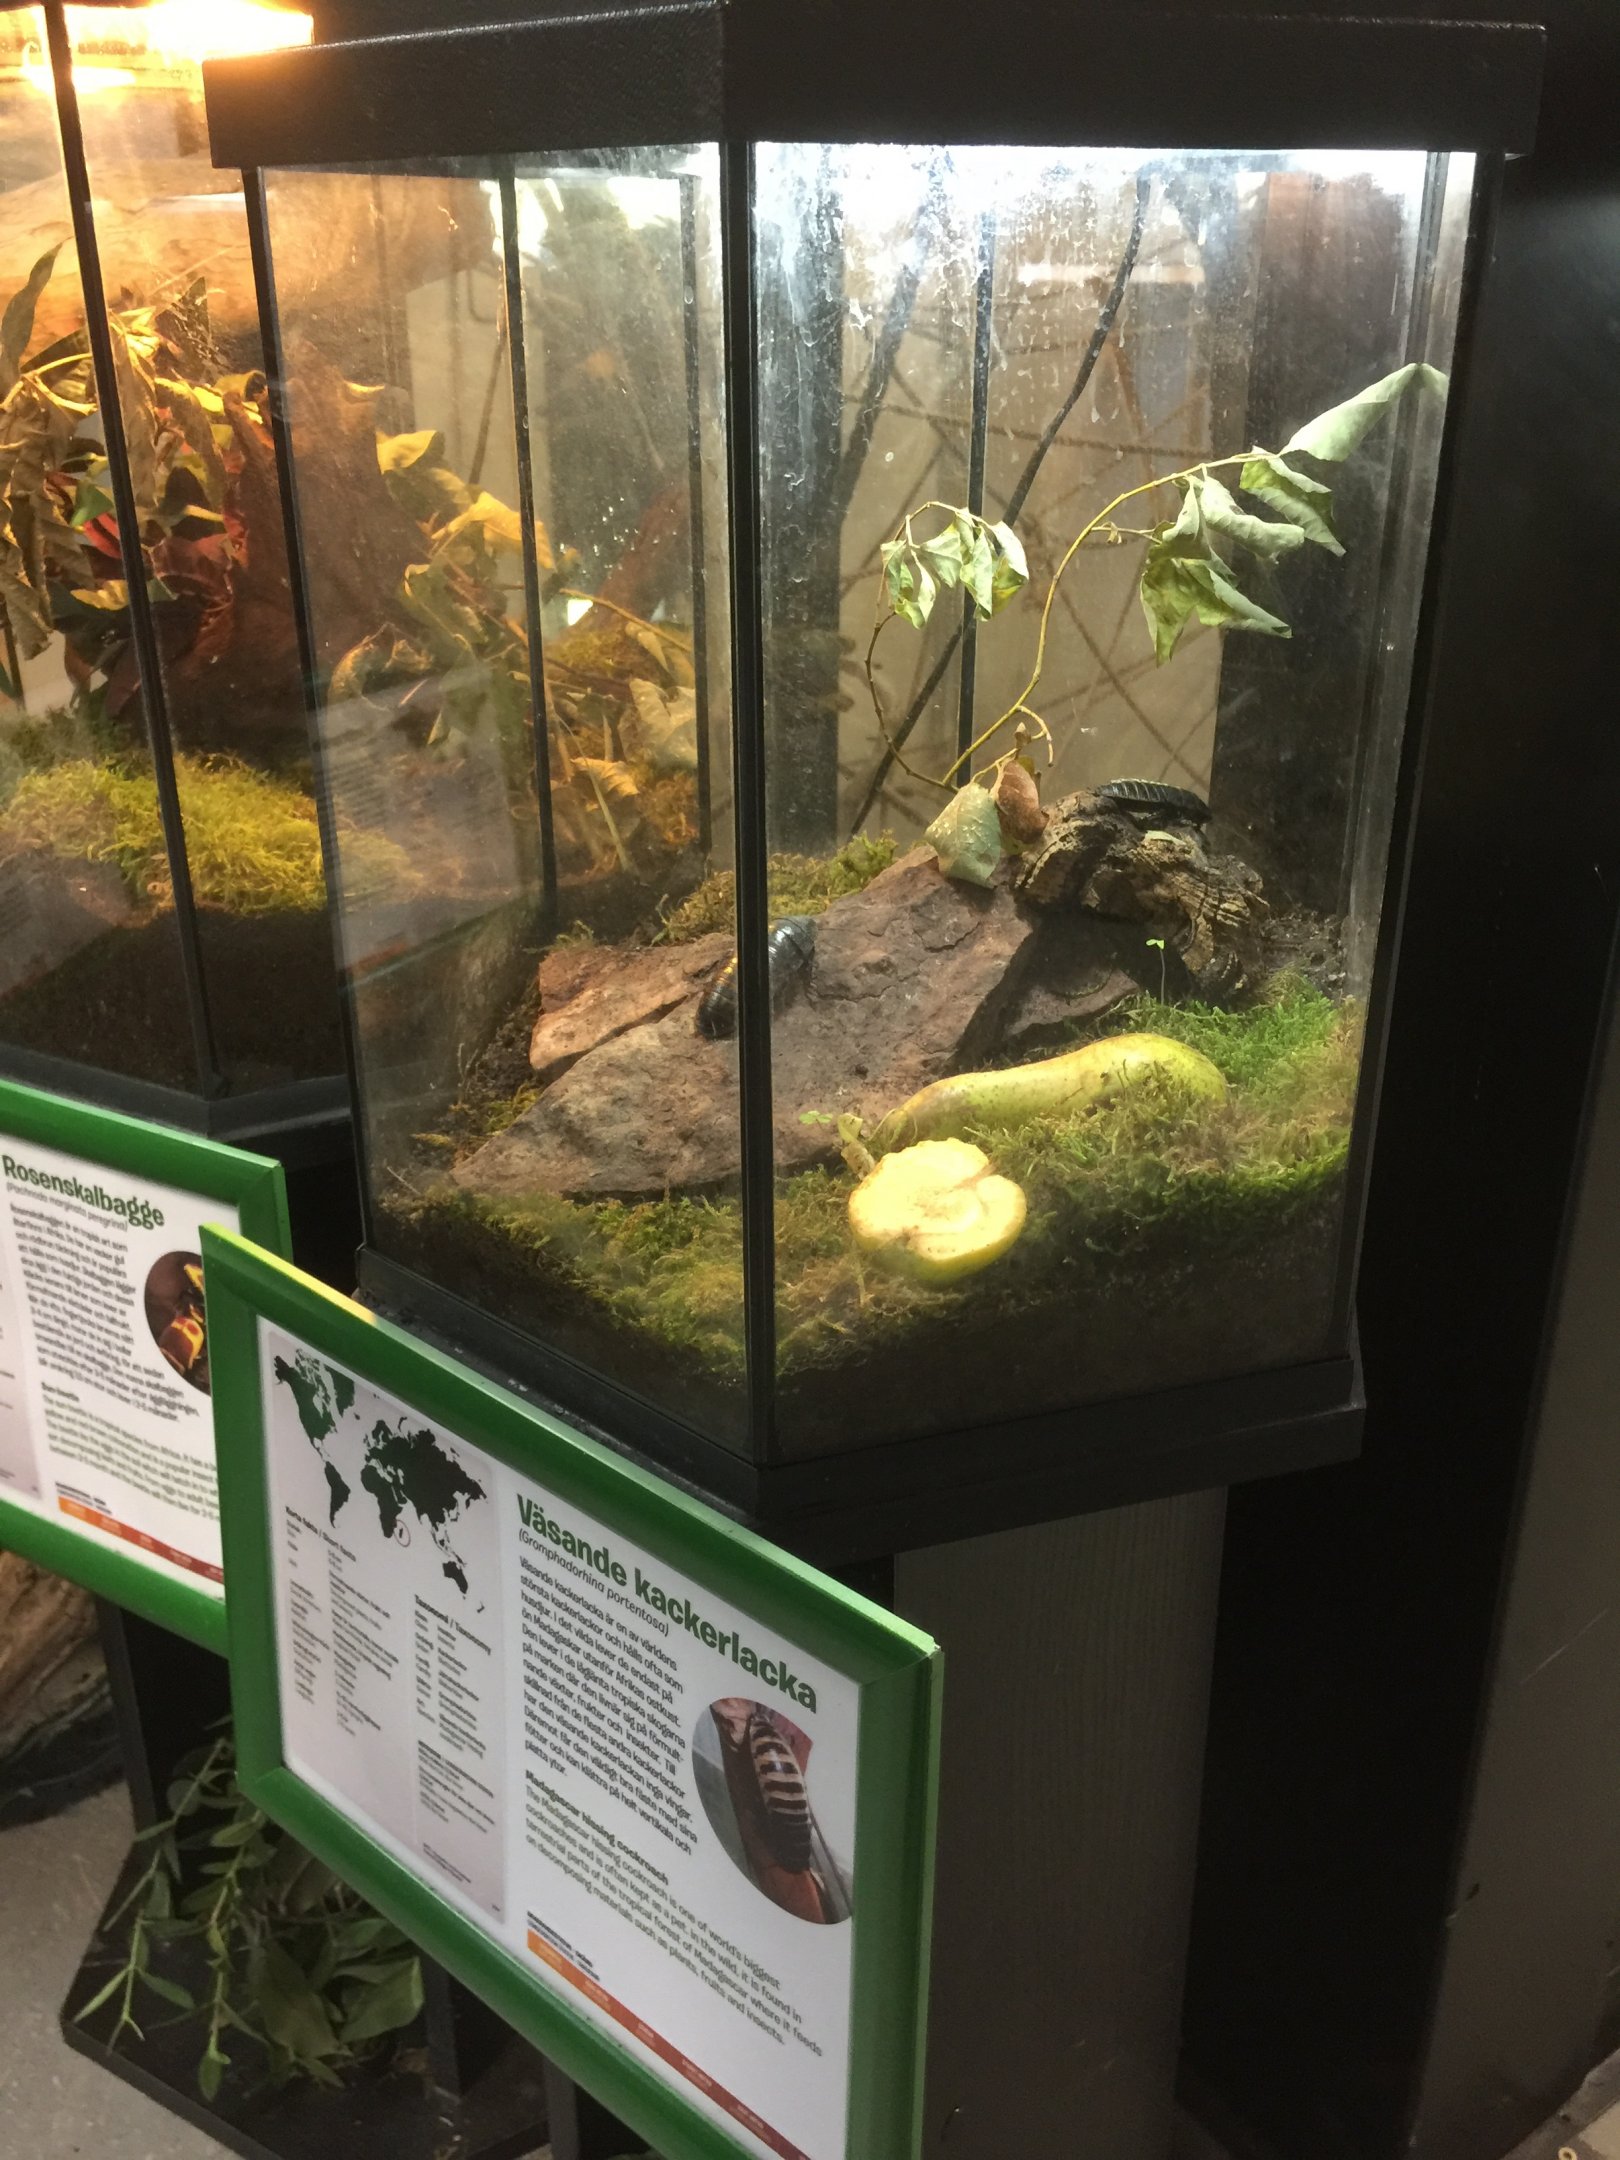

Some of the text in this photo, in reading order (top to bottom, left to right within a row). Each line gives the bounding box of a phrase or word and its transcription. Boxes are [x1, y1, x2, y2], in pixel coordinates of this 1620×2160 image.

[1, 1154, 164, 1230] Rosenskalbagge
[516, 1493, 816, 1714] Väsande kackerlacka
[518, 1527, 668, 1637] (Gromphadorhina portentosa)
[519, 1555, 553, 1586] Väsande
[554, 1578, 603, 1620] kackerlacka
[640, 1637, 677, 1671] världens
[520, 1574, 682, 1694] största kackerlackor och hålls ofta som
[520, 1589, 552, 1619] husdjur.
[558, 1616, 572, 1632] det
[574, 1627, 594, 1647] vilda
[594, 1638, 616, 1661] lever
[630, 1666, 660, 1694] endast
[522, 1622, 537, 1642] Den
[538, 1634, 558, 1655] lever
[576, 1660, 609, 1692] låglänta
[610, 1684, 645, 1718] tropiska
[646, 1712, 685, 1749] skogarna
[522, 1658, 547, 1681] nande
[576, 1694, 605, 1721] frukter
[606, 1717, 622, 1735] och
[533, 1614, 581, 1654] Madagaskar
[582, 1650, 614, 1676] utanför
[615, 1670, 644, 1700] Afrikas
[646, 1695, 680, 1727] ostkust.
[534, 1649, 564, 1677] marken
[565, 1671, 579, 1686] där
[581, 1682, 597, 1700] den
[622, 1712, 635, 1730] sig
[523, 1688, 537, 1706] har
[538, 1701, 554, 1719] den
[555, 1714, 588, 1743] väsande
[590, 1736, 644, 1785] kackerlackan
[645, 1779, 663, 1800] inga
[524, 1739, 547, 1762] platta
[524, 1704, 558, 1738] Däremot
[572, 1742, 588, 1760] den
[619, 1773, 633, 1793] bra
[658, 1806, 677, 1828] med
[679, 1823, 697, 1843] sina
[524, 1721, 548, 1745] fötter
[549, 1741, 564, 1758] och
[564, 1751, 580, 1770] kan
[580, 1761, 608, 1790] klättra
[620, 1791, 637, 1812] helt
[638, 1807, 673, 1842] vertikala
[674, 1836, 691, 1855] och
[553, 1694, 570, 1714] från
[583, 1714, 607, 1740] flesta
[608, 1734, 631, 1758] andra
[632, 1750, 685, 1798] kackerlackor
